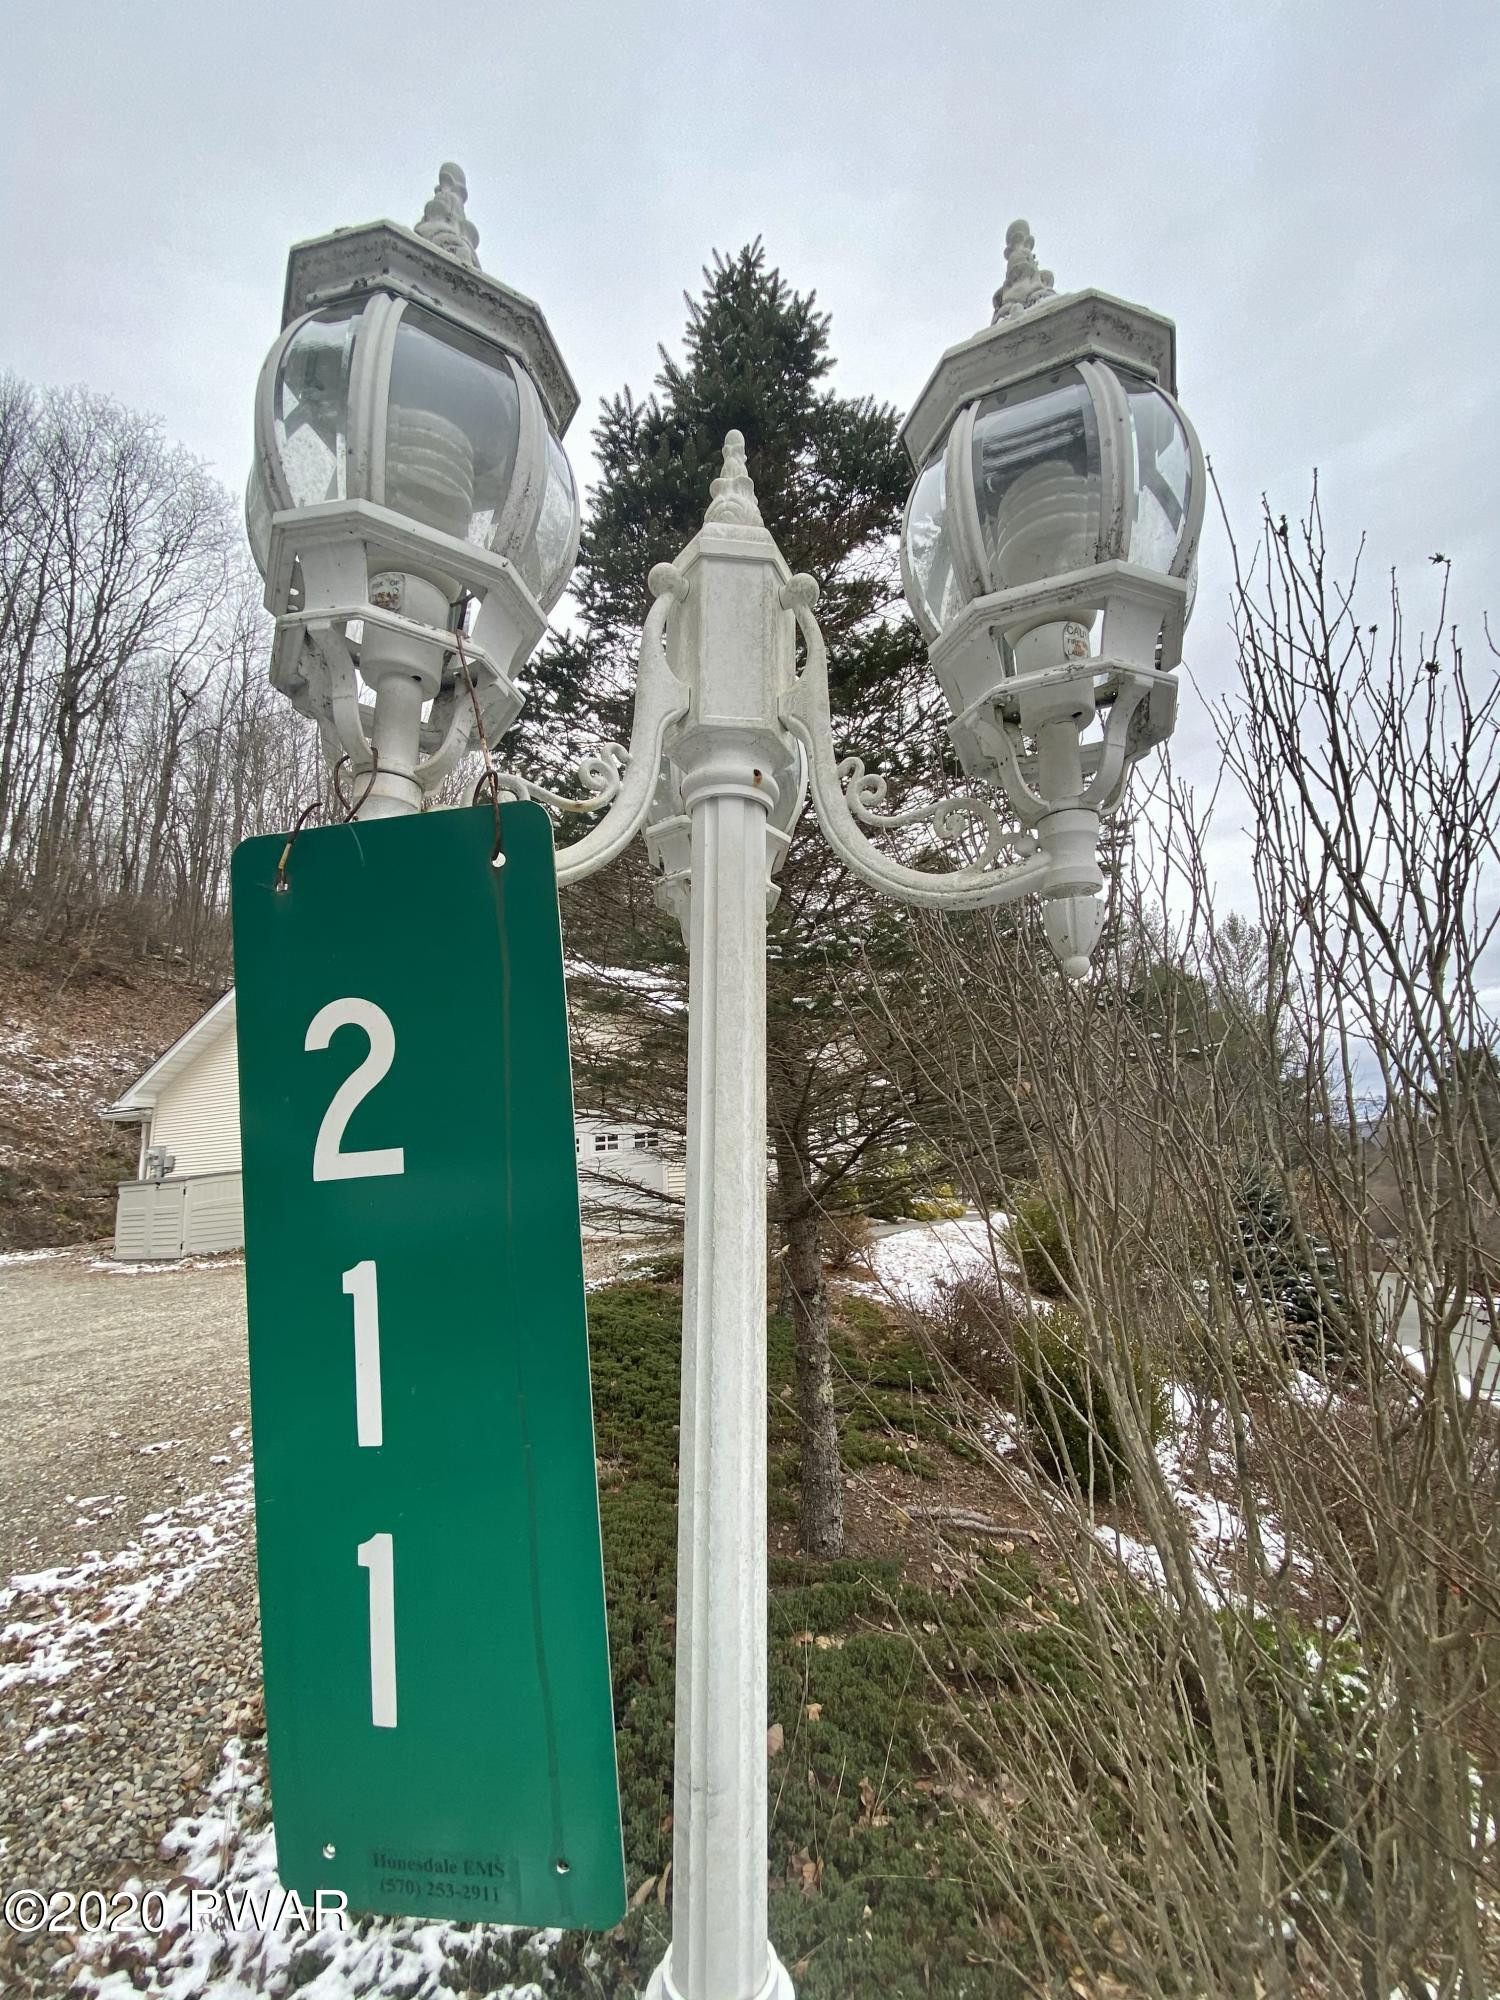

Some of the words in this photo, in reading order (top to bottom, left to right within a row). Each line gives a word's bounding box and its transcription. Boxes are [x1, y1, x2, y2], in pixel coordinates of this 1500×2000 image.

[463, 1859, 505, 1878] EMS
[380, 1878, 421, 1898] (570)
[426, 1881, 499, 1902] 253-2911
